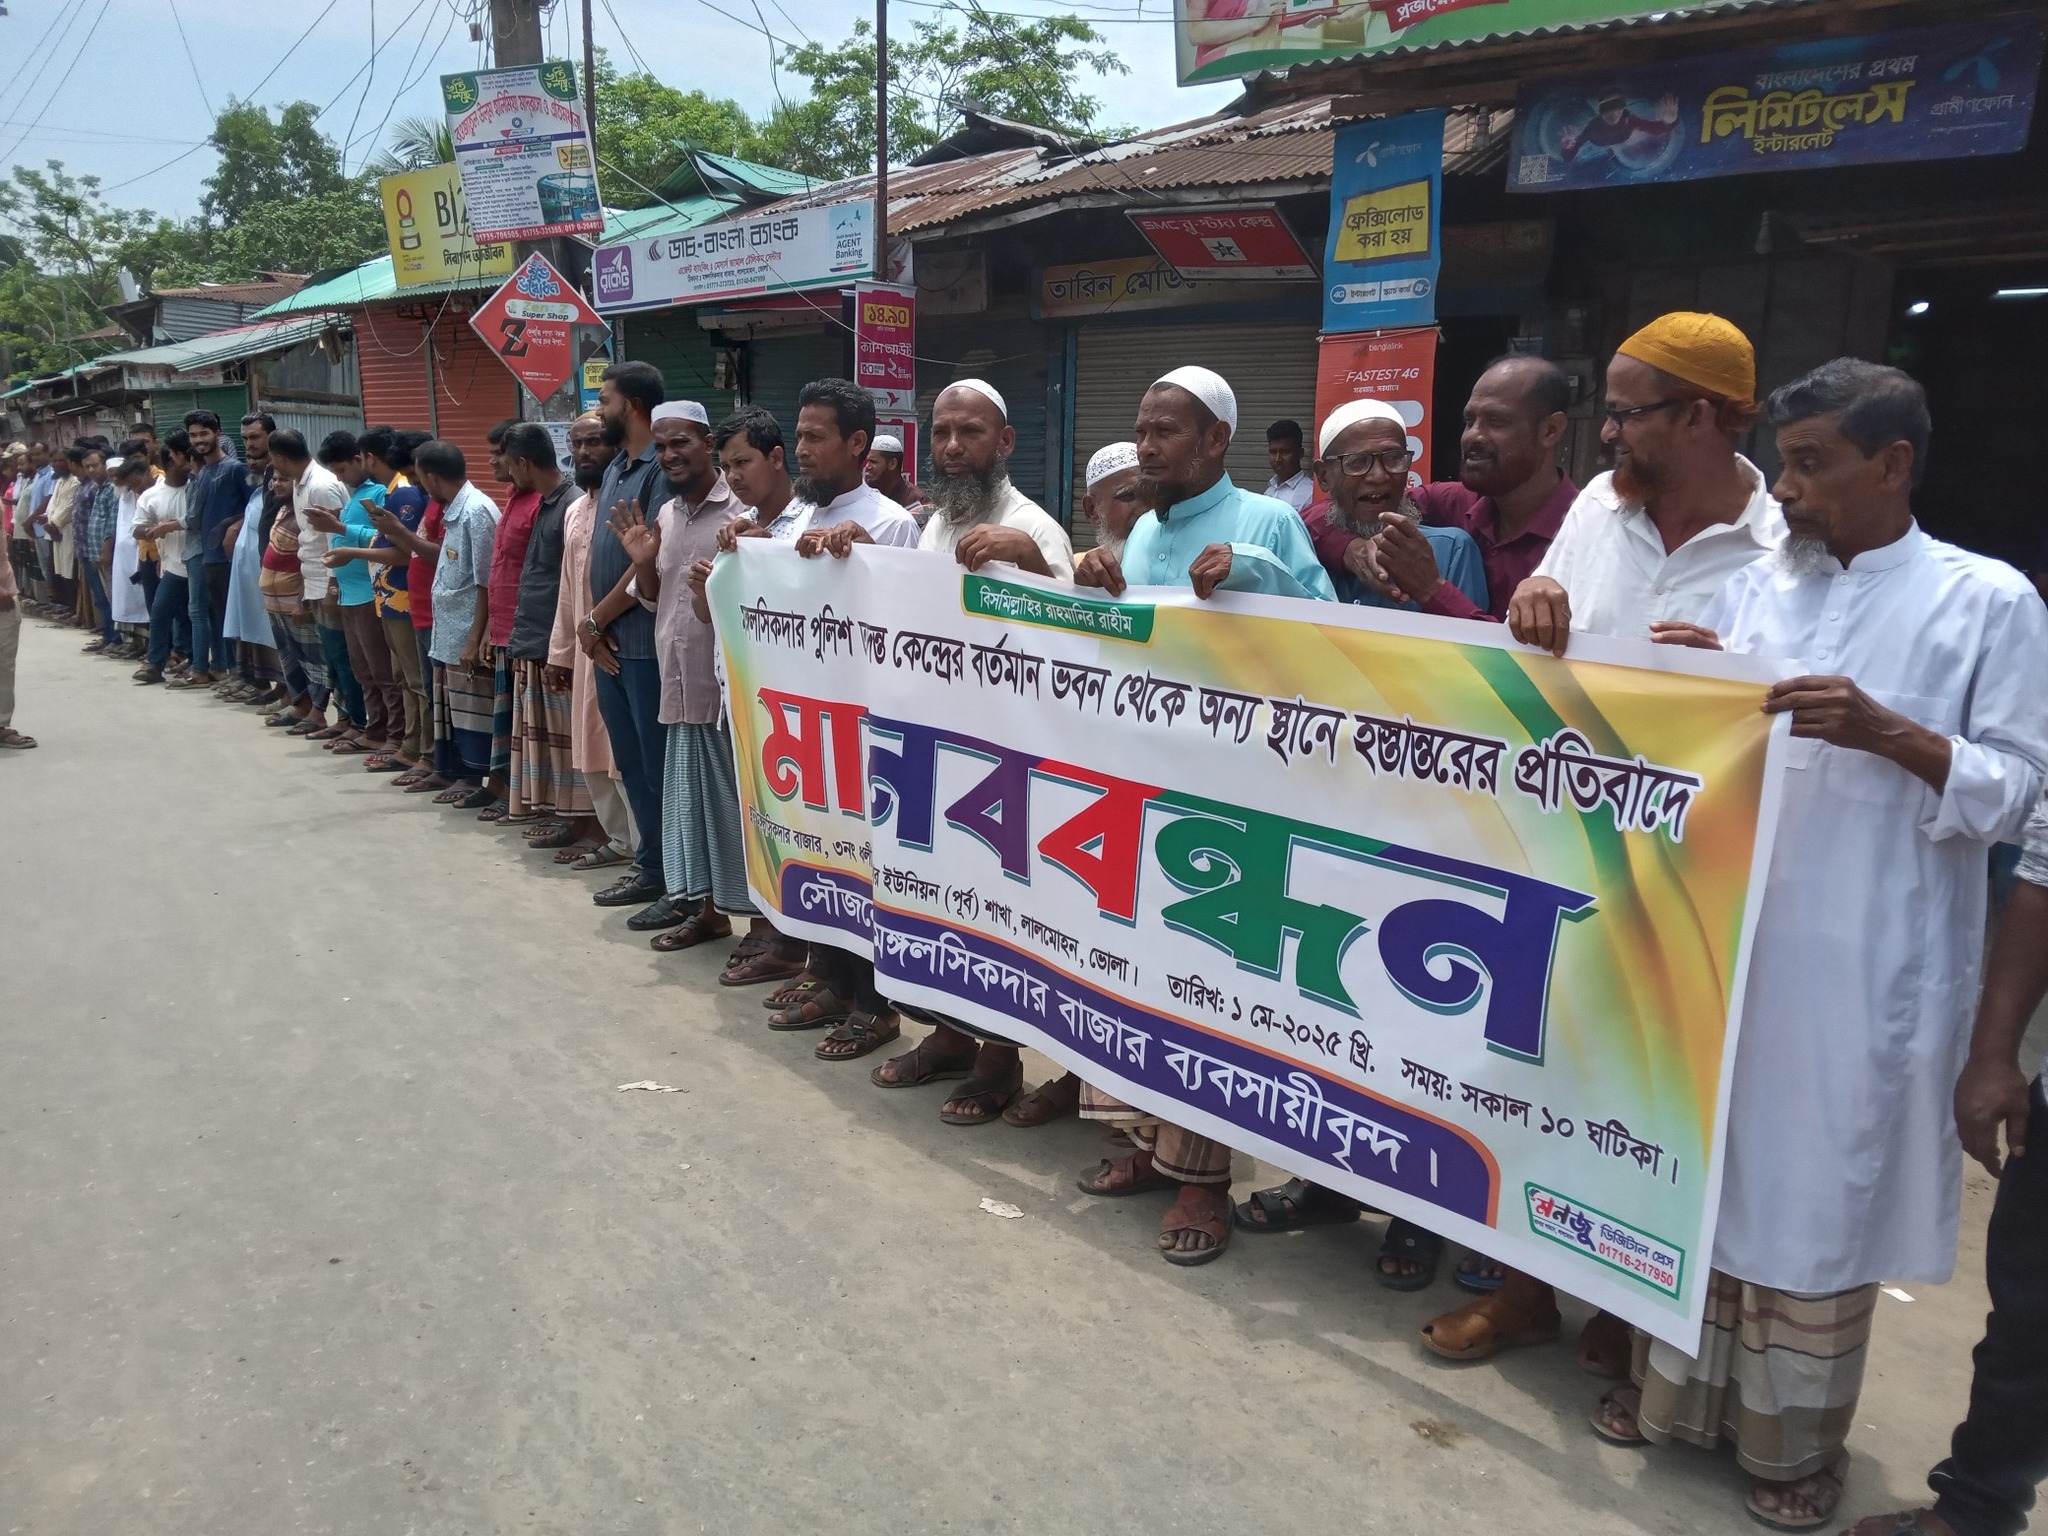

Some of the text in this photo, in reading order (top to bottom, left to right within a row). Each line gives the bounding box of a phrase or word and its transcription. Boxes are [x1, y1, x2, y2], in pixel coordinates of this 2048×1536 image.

[1756, 55, 1918, 90] বাংলাদেশের প্রথম
[1701, 80, 1916, 143] লিমিটলেস
[1754, 128, 1835, 155] ইন্টারনেট
[1141, 220, 1180, 231] SMC
[1238, 215, 1276, 229] কেন্দ্র
[1346, 204, 1425, 231] ফ্লেক্সিলোড
[668, 217, 798, 260] ডাচ্-বাংলা ব্যাংক
[837, 238, 862, 249] AGENT
[1357, 227, 1413, 248] করা হয়
[836, 247, 863, 259] Banking
[527, 264, 551, 281] শুভ
[1048, 269, 1115, 299] তারিন
[1333, 288, 1345, 299] 4G
[522, 310, 569, 321] Super Shop
[860, 341, 912, 356] ক্যাশ আউট
[1369, 342, 1404, 352] banglalink
[1346, 367, 1420, 383] FASTEST 4G
[979, 585, 1133, 634] বিসমিল্লাহির রাহমানির রাহীম
[810, 604, 854, 664] পুলিশ
[893, 630, 965, 687] কেন্দ্রের
[970, 633, 1045, 702] বর্তমান
[1051, 660, 1112, 715] ভবন
[1114, 668, 1193, 728] থেকে
[1199, 686, 1264, 745] অন্য
[1267, 696, 1348, 767] স্থানে
[1353, 714, 1506, 796] হস্তান্তরের
[1514, 731, 1700, 839] প্রতিবাদে
[757, 686, 1600, 1065] মানববন্ধন
[883, 867, 941, 902] ইউনিয়ন
[945, 884, 980, 922] (পূর্ব)
[1166, 974, 1225, 1014] তারিখ:
[1231, 996, 1243, 1021] ১
[1250, 1004, 1342, 1058] মে-২০২৫
[1349, 1029, 1376, 1075] খ্রি.
[1400, 1057, 1452, 1102] সময়:
[1460, 1081, 1533, 1128] সকাল
[1540, 1106, 1575, 1139] ১০
[1585, 1119, 1664, 1178] ঘটিকা
[873, 921, 1051, 1018] মঙ্গলসিকদার
[1055, 989, 1153, 1071] বাজার
[1161, 1038, 1411, 1174] ব্যবসায়ীবৃন্দ
[1600, 1223, 1676, 1270] ডিজিটাল প্রেস
[1599, 1242, 1674, 1287] 01716-217950
